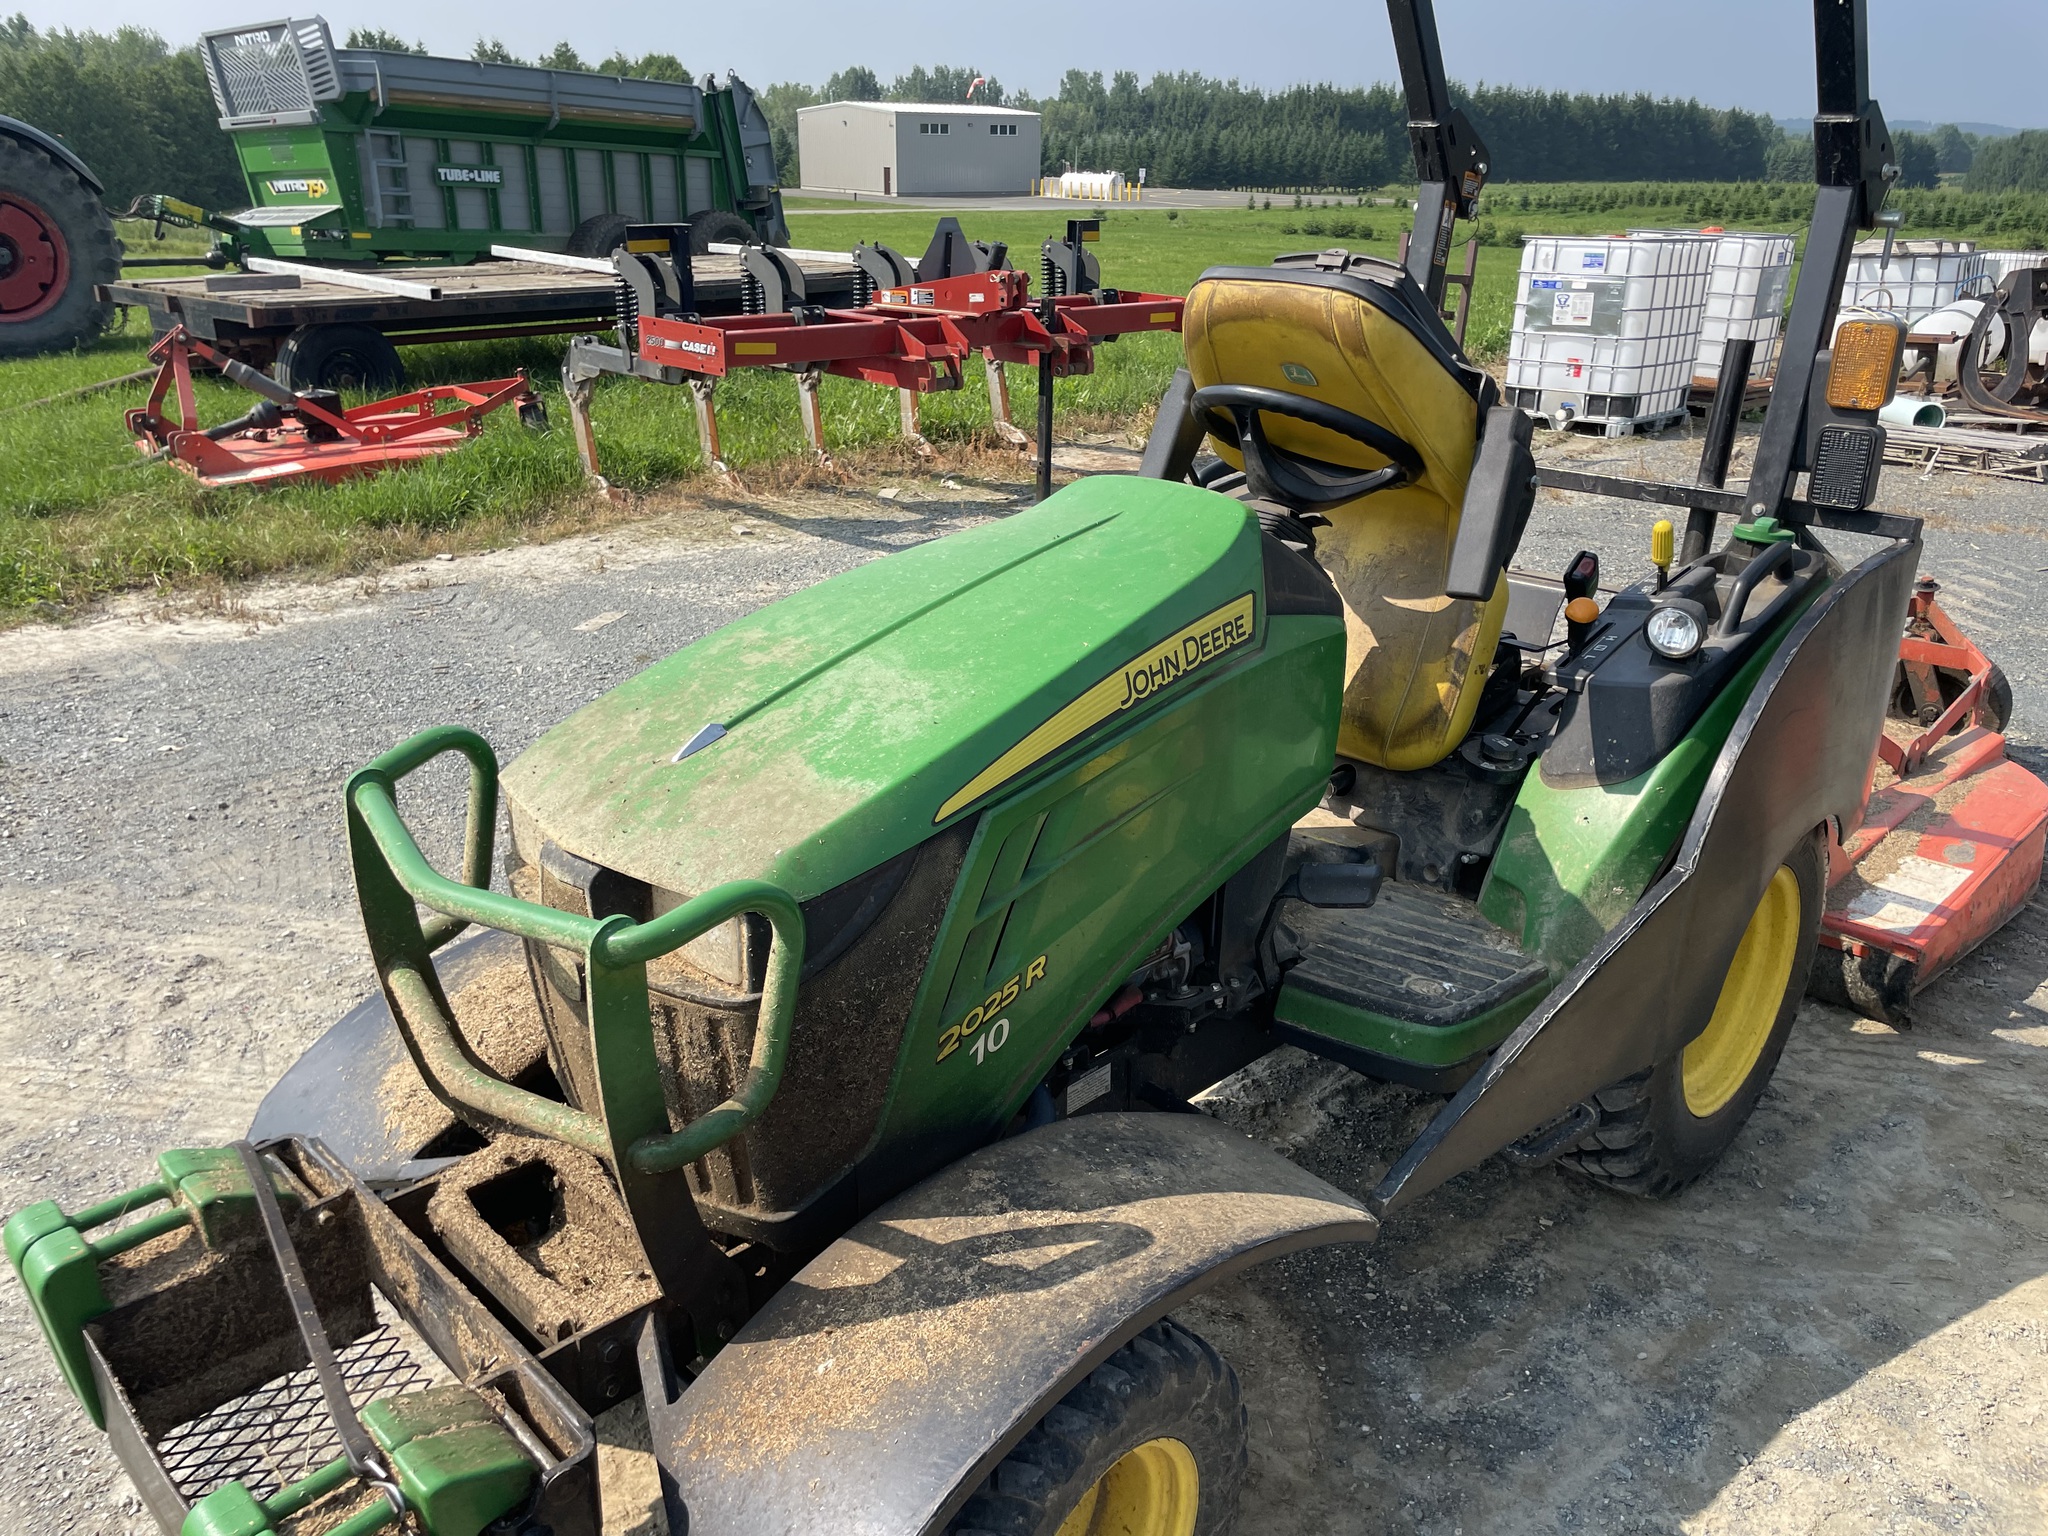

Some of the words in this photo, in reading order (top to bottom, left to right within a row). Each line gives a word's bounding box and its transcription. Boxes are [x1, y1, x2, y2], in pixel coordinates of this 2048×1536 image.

[234, 30, 270, 47] NITRO
[271, 179, 308, 193] NITRO
[306, 179, 329, 199] 750
[646, 335, 665, 348] 2500
[681, 340, 707, 354] CASE
[1119, 650, 1180, 707] JOHN
[1181, 614, 1248, 669] DEERE
[969, 1018, 1010, 1066] 10
